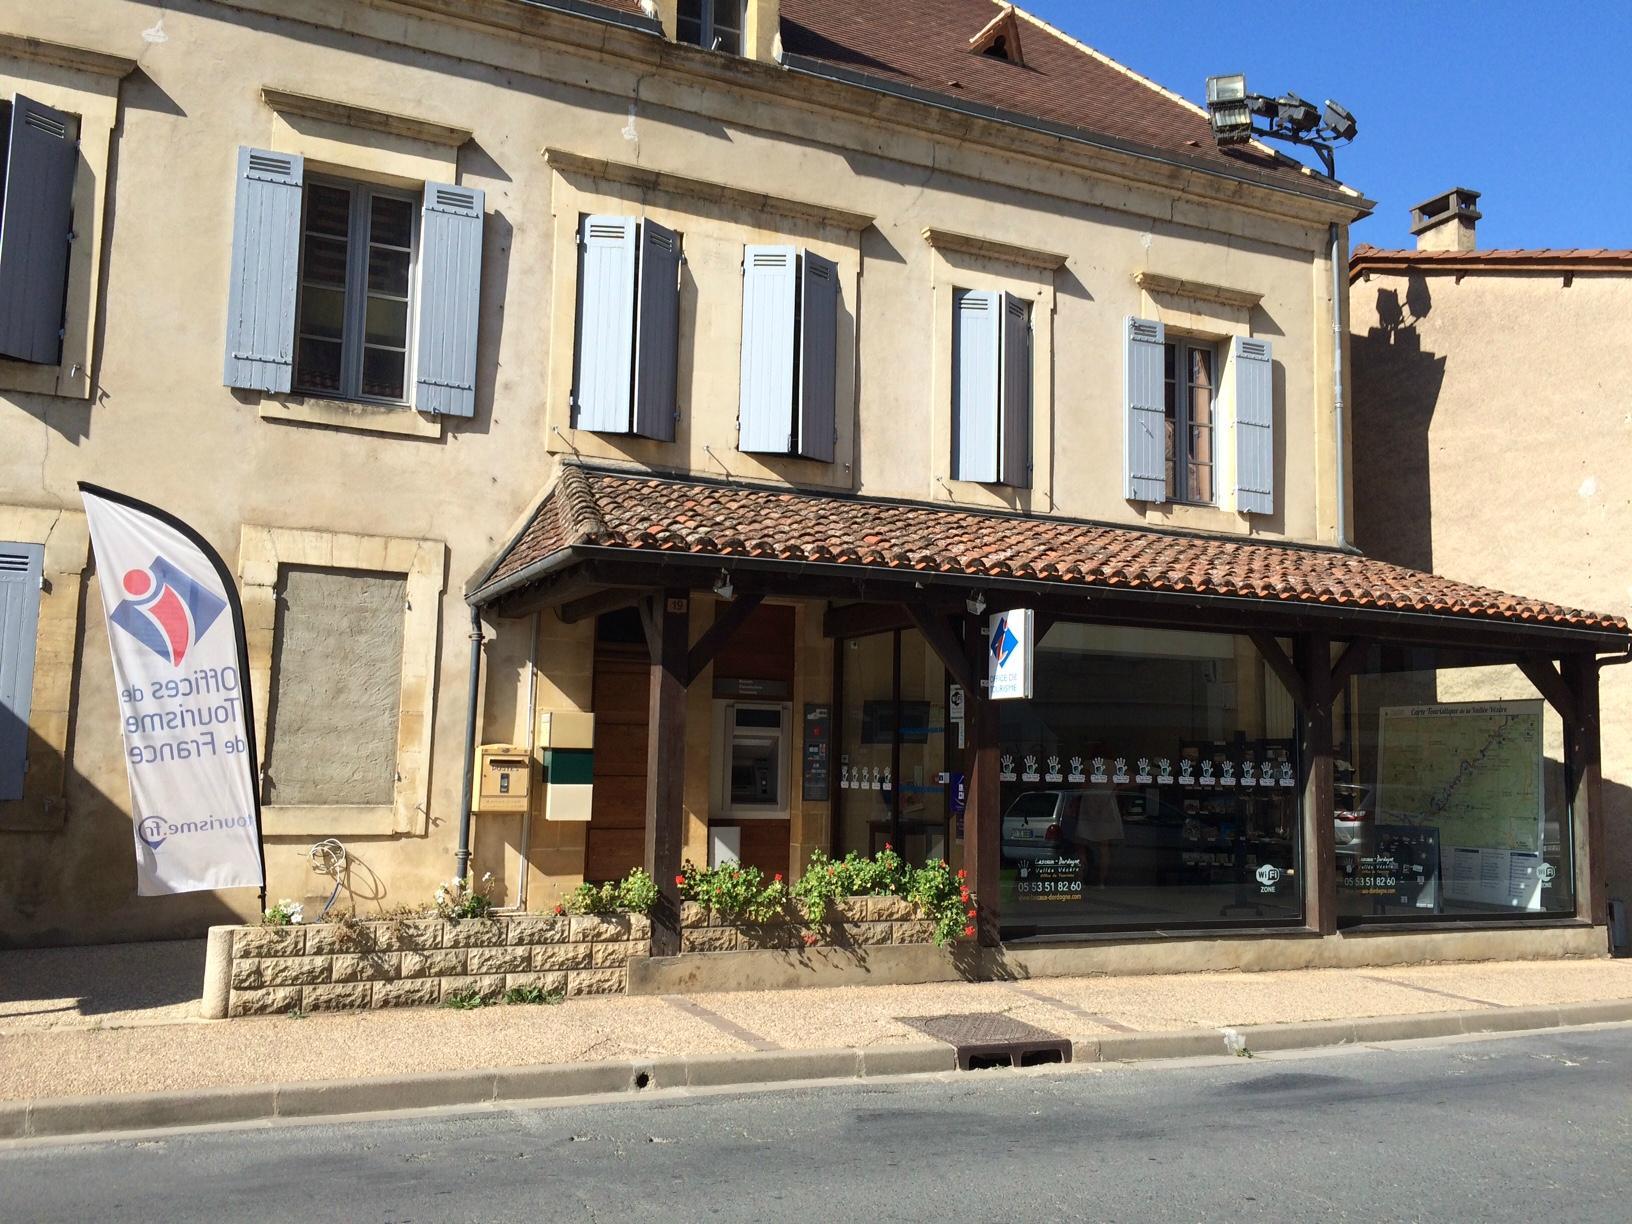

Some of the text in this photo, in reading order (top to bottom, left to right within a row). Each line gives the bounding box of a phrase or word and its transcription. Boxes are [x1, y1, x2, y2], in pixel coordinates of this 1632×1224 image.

[1344, 877, 1396, 886] 05 53 51 82 60
[1018, 882, 1082, 892] 05 53 51 82 60
